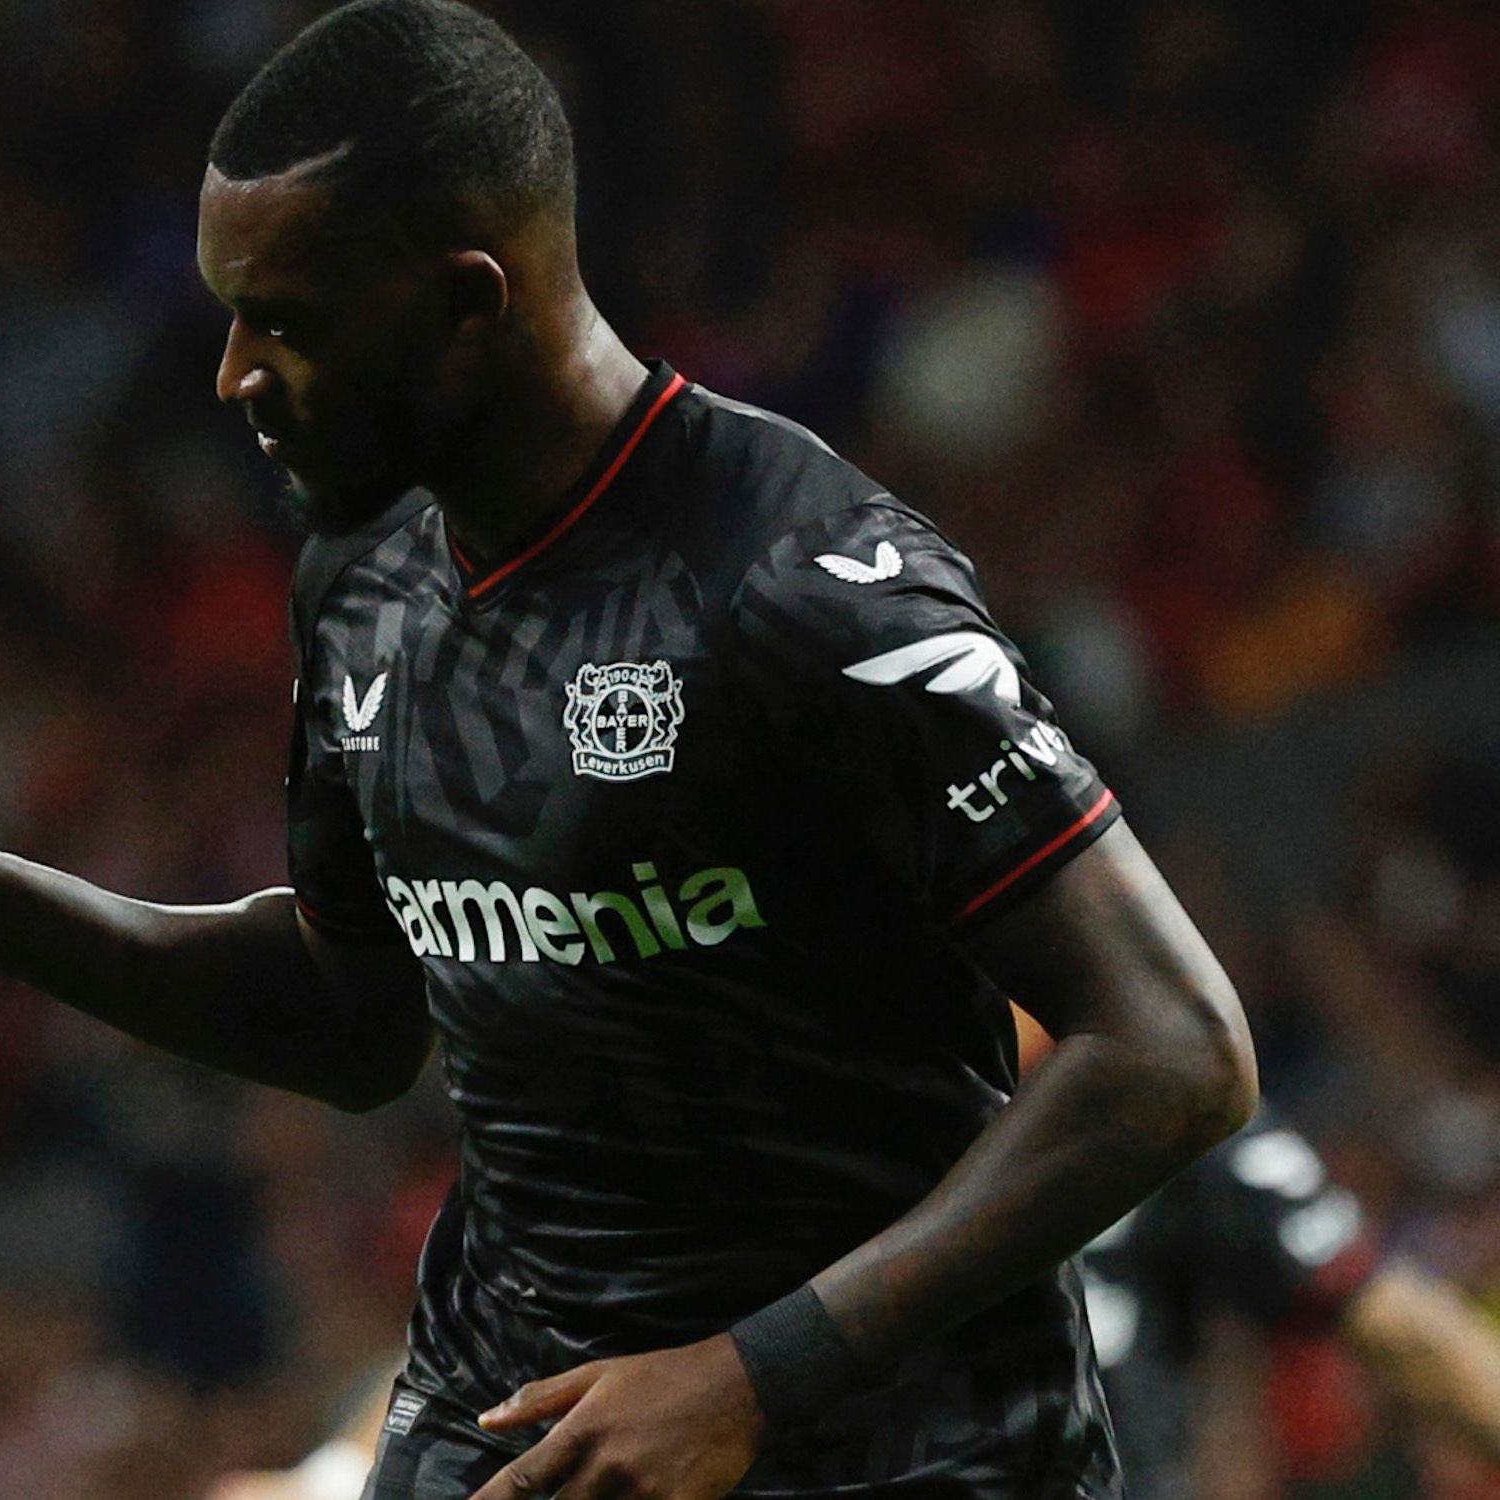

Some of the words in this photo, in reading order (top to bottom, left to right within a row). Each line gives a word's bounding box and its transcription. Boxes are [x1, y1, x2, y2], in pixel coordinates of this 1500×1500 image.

[609, 670, 638, 683] 1904
[597, 715, 648, 728] BAYER
[580, 753, 665, 775] Leverkusen
[385, 861, 767, 966] armenia
